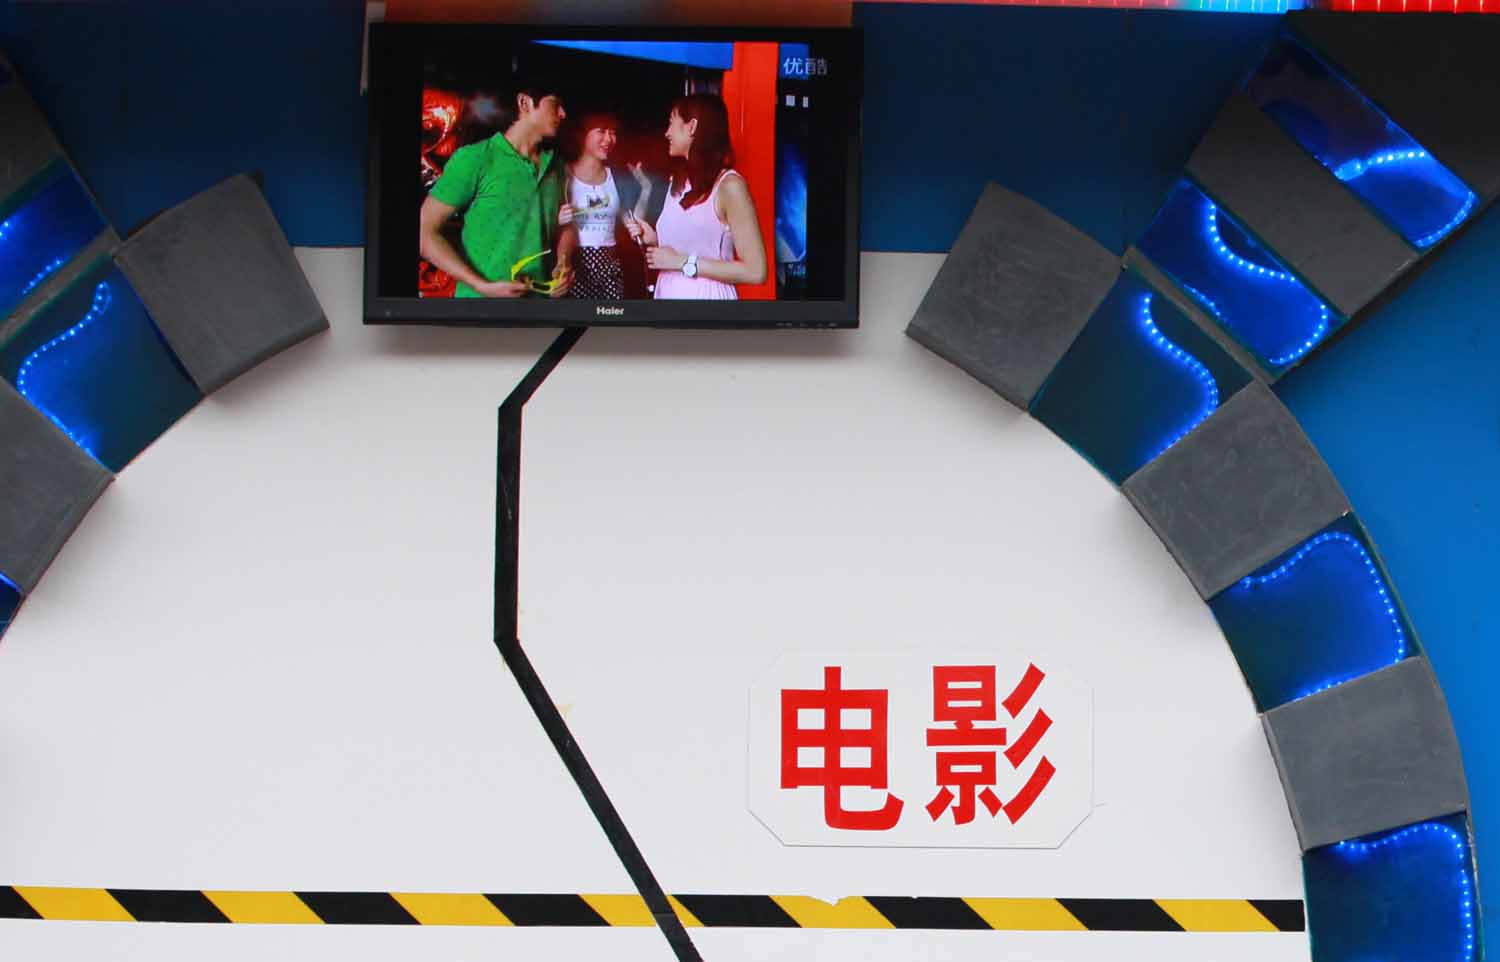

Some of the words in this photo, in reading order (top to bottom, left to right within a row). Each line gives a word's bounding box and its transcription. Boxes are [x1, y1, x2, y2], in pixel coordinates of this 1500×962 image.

[783, 57, 828, 76] 优酷
[596, 306, 625, 316] Haier
[779, 662, 1057, 832] 电影
